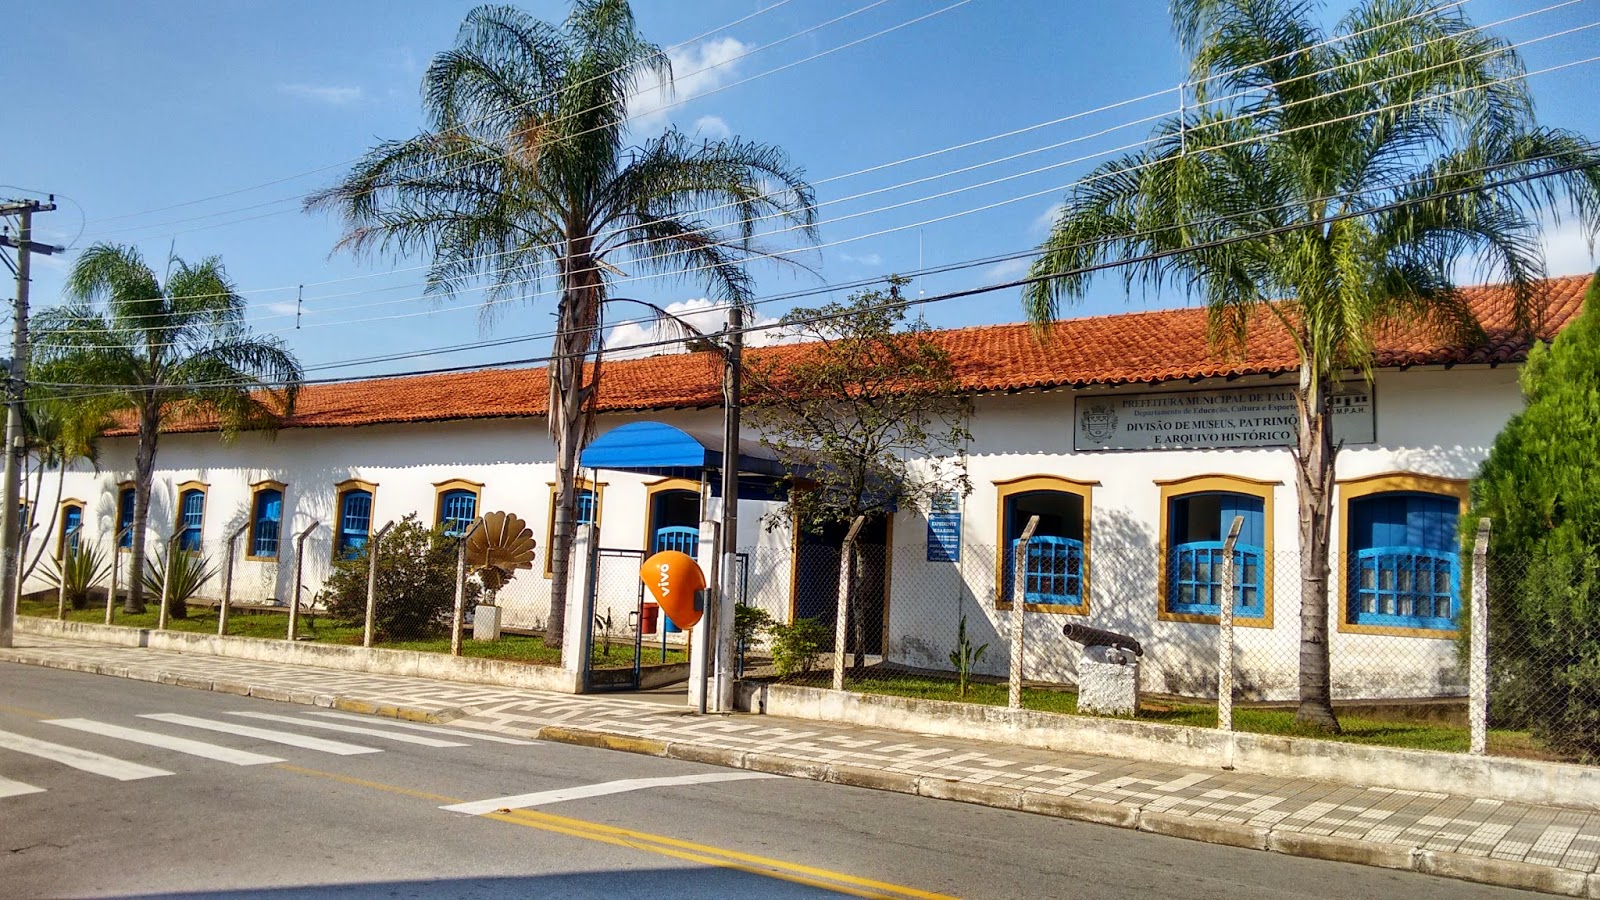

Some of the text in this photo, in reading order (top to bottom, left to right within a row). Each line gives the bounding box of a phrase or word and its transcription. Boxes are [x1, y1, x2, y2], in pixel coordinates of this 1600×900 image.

[1122, 392, 1296, 408] PREFEITURA MUNICIPAL DE TAUB
[1134, 409, 1181, 417] Departamento
[1231, 405, 1260, 413] Cultura
[1127, 414, 1299, 431] DIVISÃO DE MUSEUS, PATRIMÔ
[1154, 429, 1290, 445] E ARQUIVO HISTÓRICO
[657, 563, 671, 597] vivo
